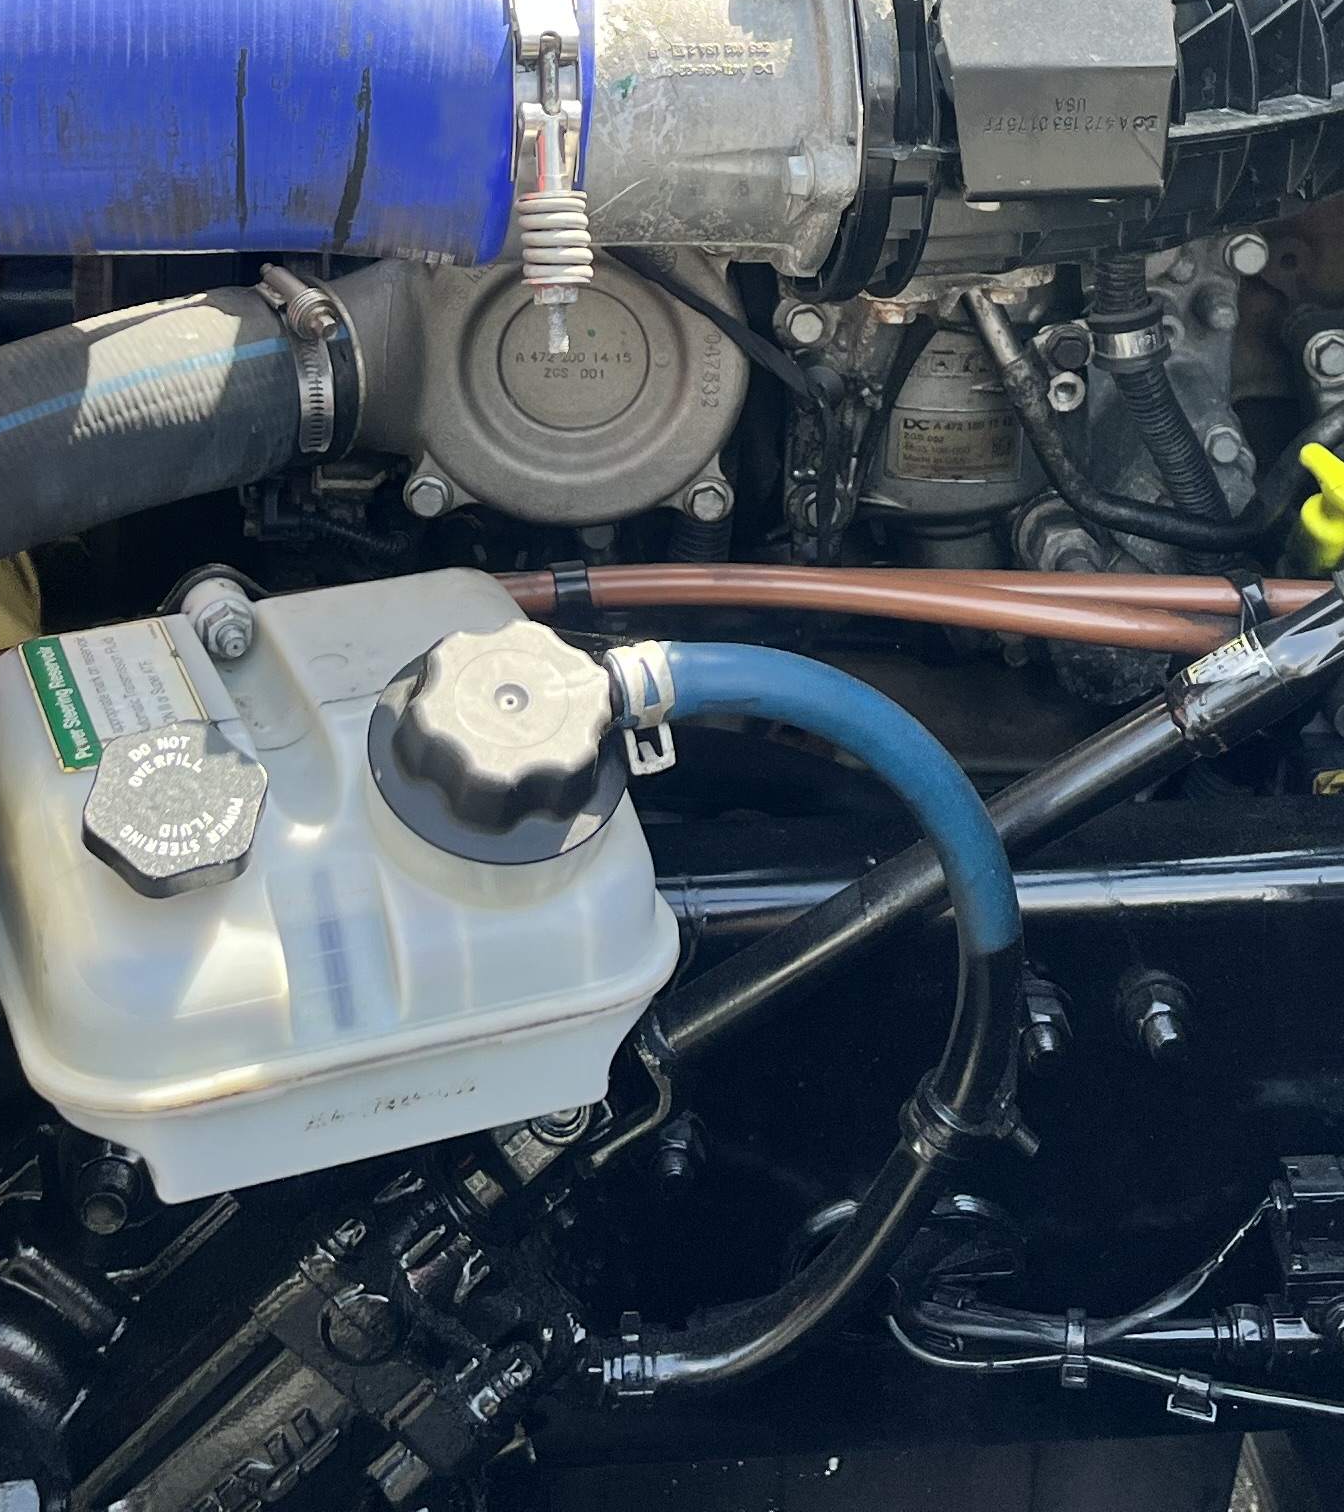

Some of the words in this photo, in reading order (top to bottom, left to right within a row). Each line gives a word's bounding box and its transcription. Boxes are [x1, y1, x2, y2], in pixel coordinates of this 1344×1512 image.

[1055, 97, 1087, 113] USA
[984, 116, 1003, 132] FF
[1007, 116, 1026, 132] 75
[1054, 116, 1079, 132] 153
[1119, 116, 1129, 132] A
[515, 352, 524, 363] A
[531, 352, 555, 363] 472
[594, 352, 609, 363] 14
[616, 352, 633, 363] 15
[544, 368, 568, 379] ZGS
[903, 418, 930, 431] DC
[933, 420, 942, 430] A
[38, 645, 66, 688] Reservoir
[55, 685, 81, 730] Steering
[70, 728, 92, 761] Power
[128, 743, 151, 763] DO
[156, 736, 191, 750] NOT
[128, 752, 204, 788] OVERFILL
[159, 811, 214, 838] FLUID
[205, 797, 244, 845] POWER
[119, 824, 201, 857] STEERING
